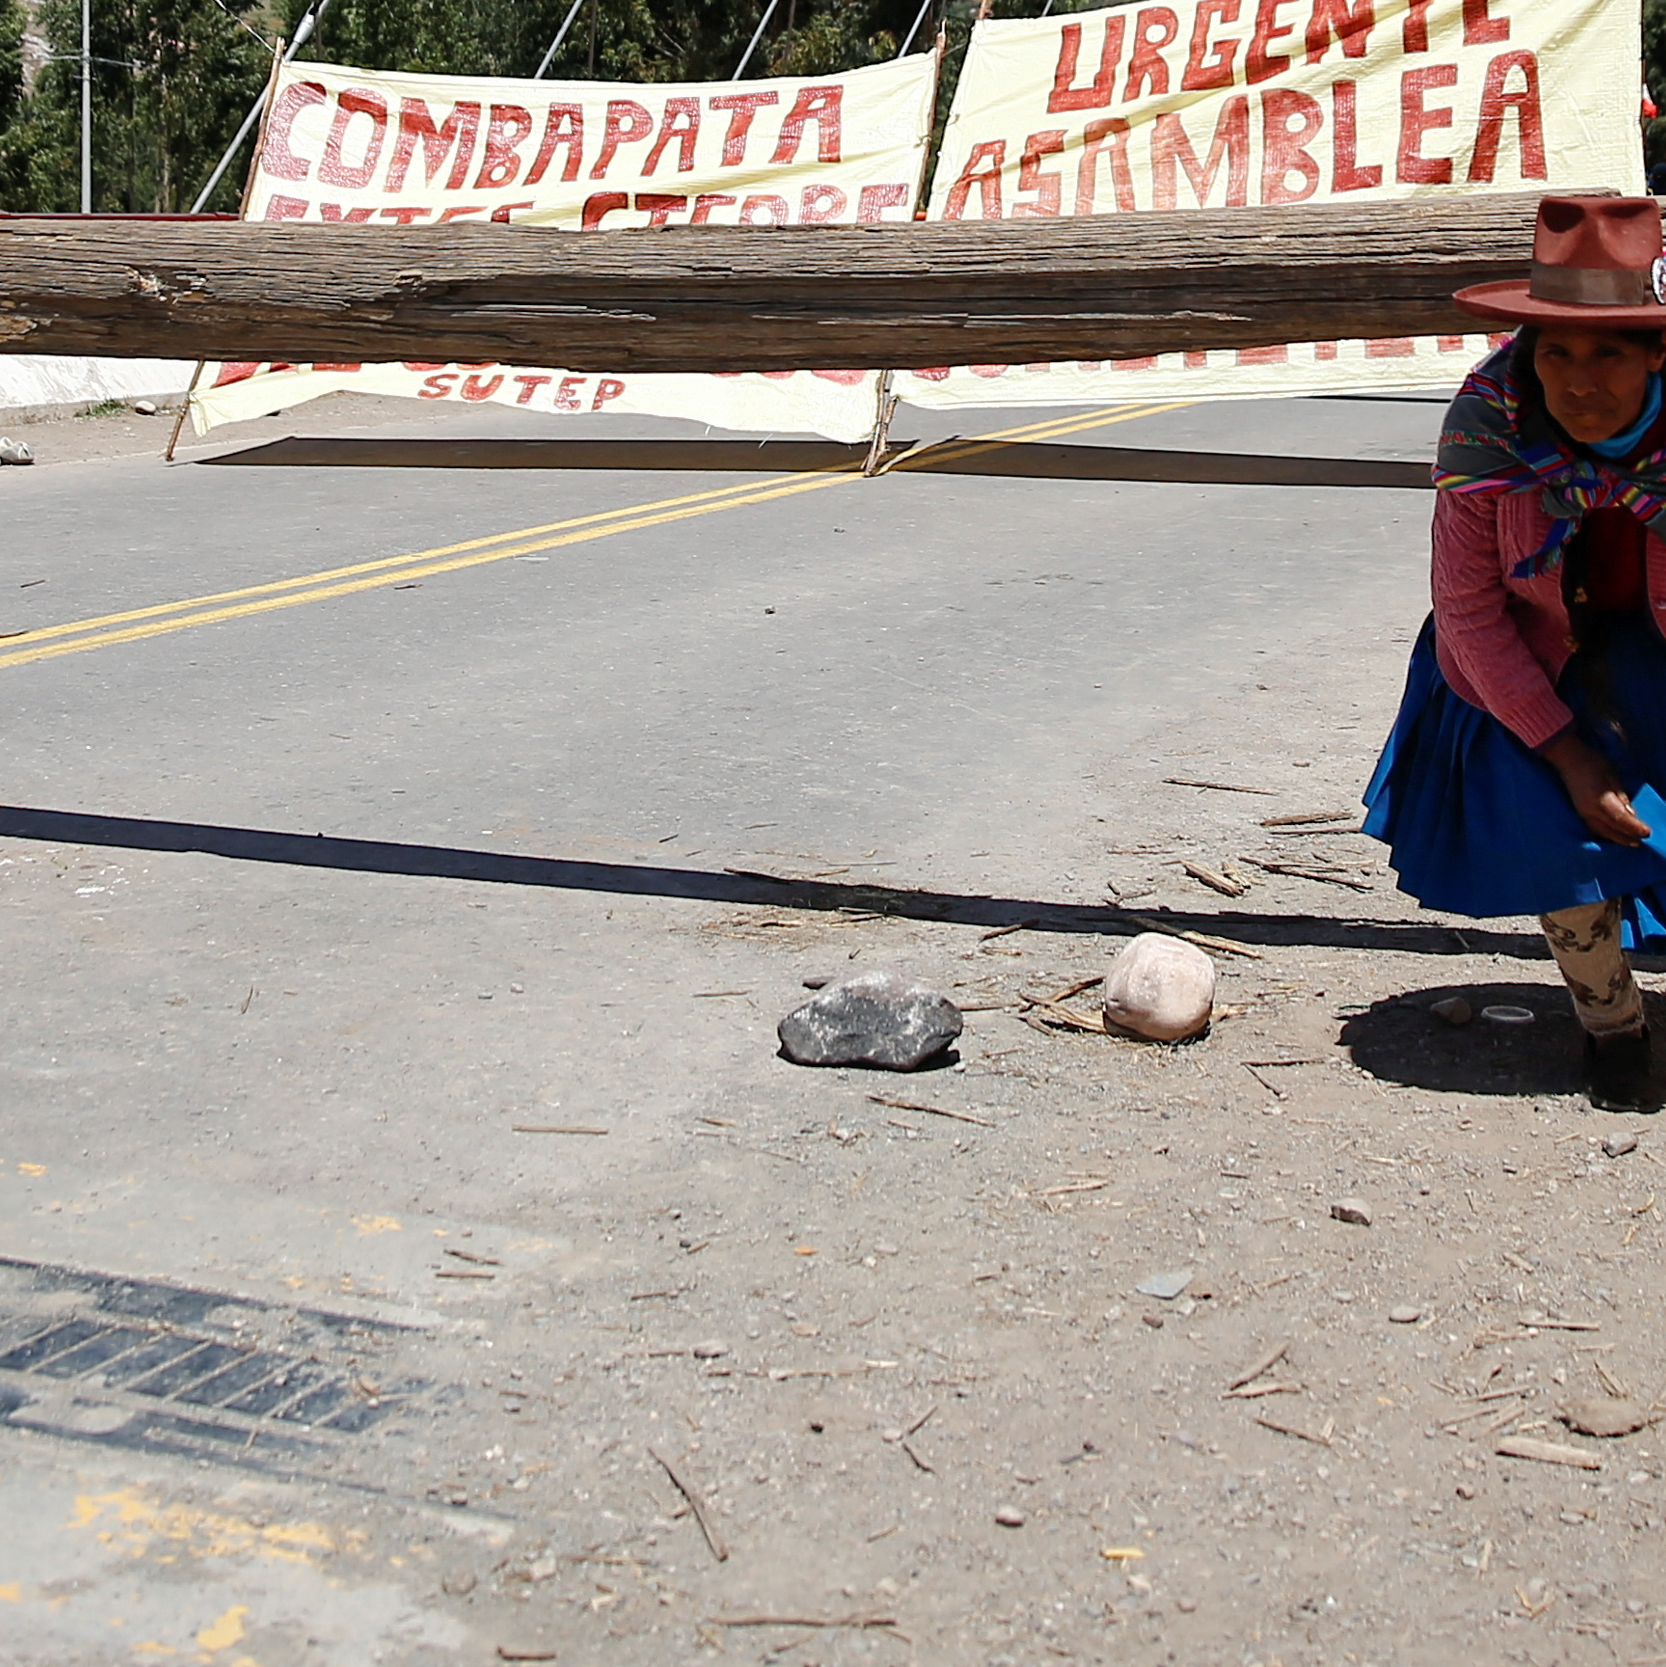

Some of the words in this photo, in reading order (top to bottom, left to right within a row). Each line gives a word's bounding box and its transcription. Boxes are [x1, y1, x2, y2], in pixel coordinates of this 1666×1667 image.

[261, 80, 845, 193] COMBAPATA
[942, 49, 1548, 221] ASAMBLEA
[417, 372, 627, 412] SUTEP
